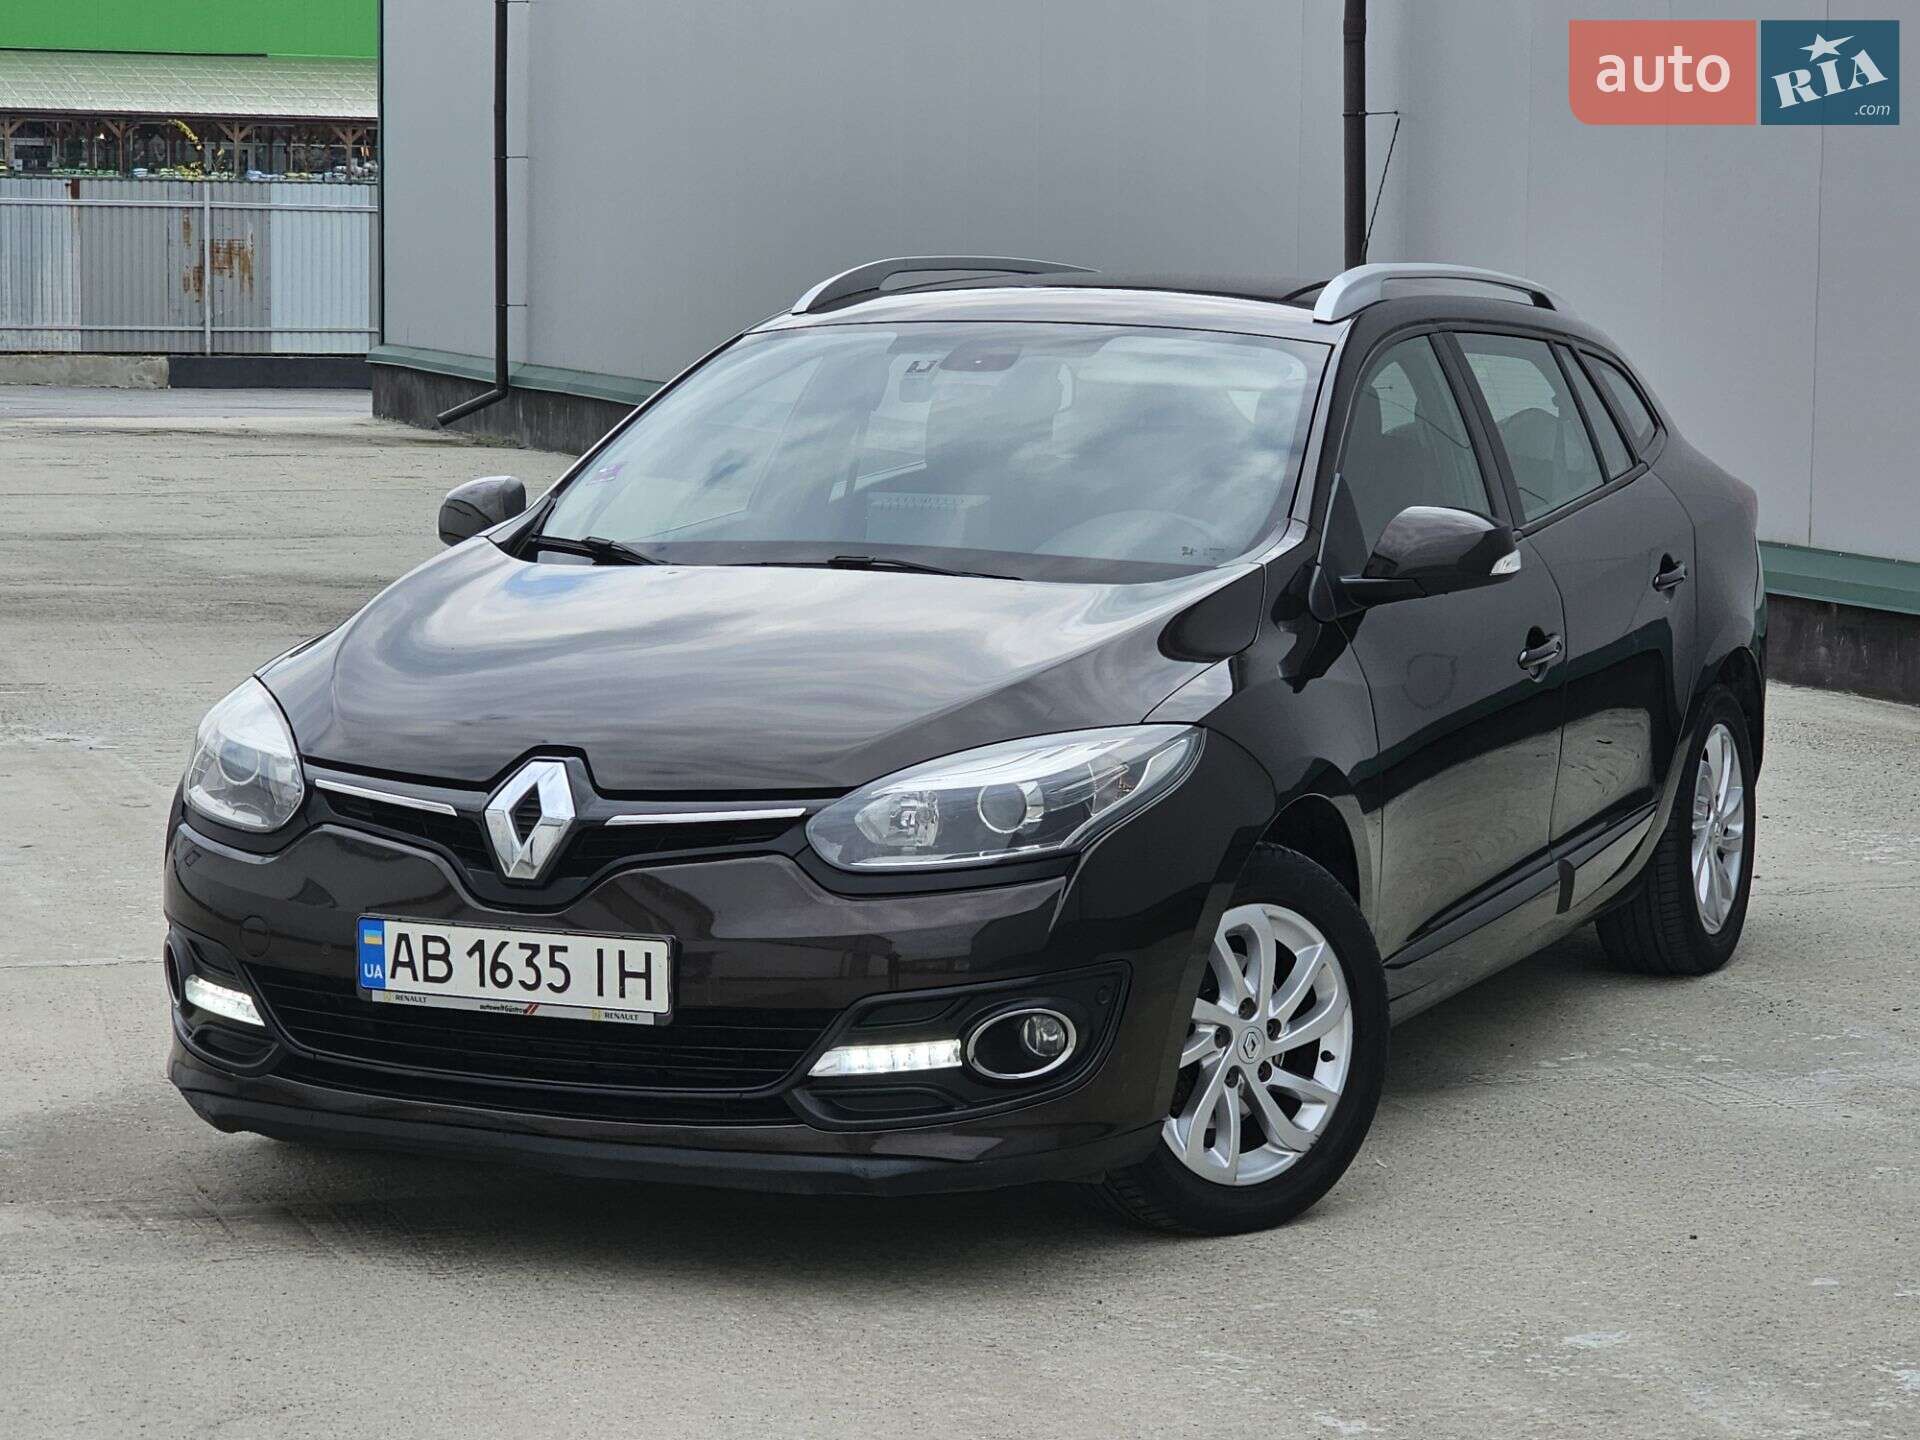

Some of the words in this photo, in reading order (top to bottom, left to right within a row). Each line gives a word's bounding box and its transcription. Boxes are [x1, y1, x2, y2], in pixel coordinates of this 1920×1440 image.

[364, 963, 383, 979] UA
[390, 932, 454, 984] AB
[466, 938, 571, 994] 1635
[596, 947, 652, 1001] IH
[394, 993, 428, 1004] RENAULT
[604, 1012, 640, 1022] RENAULT
